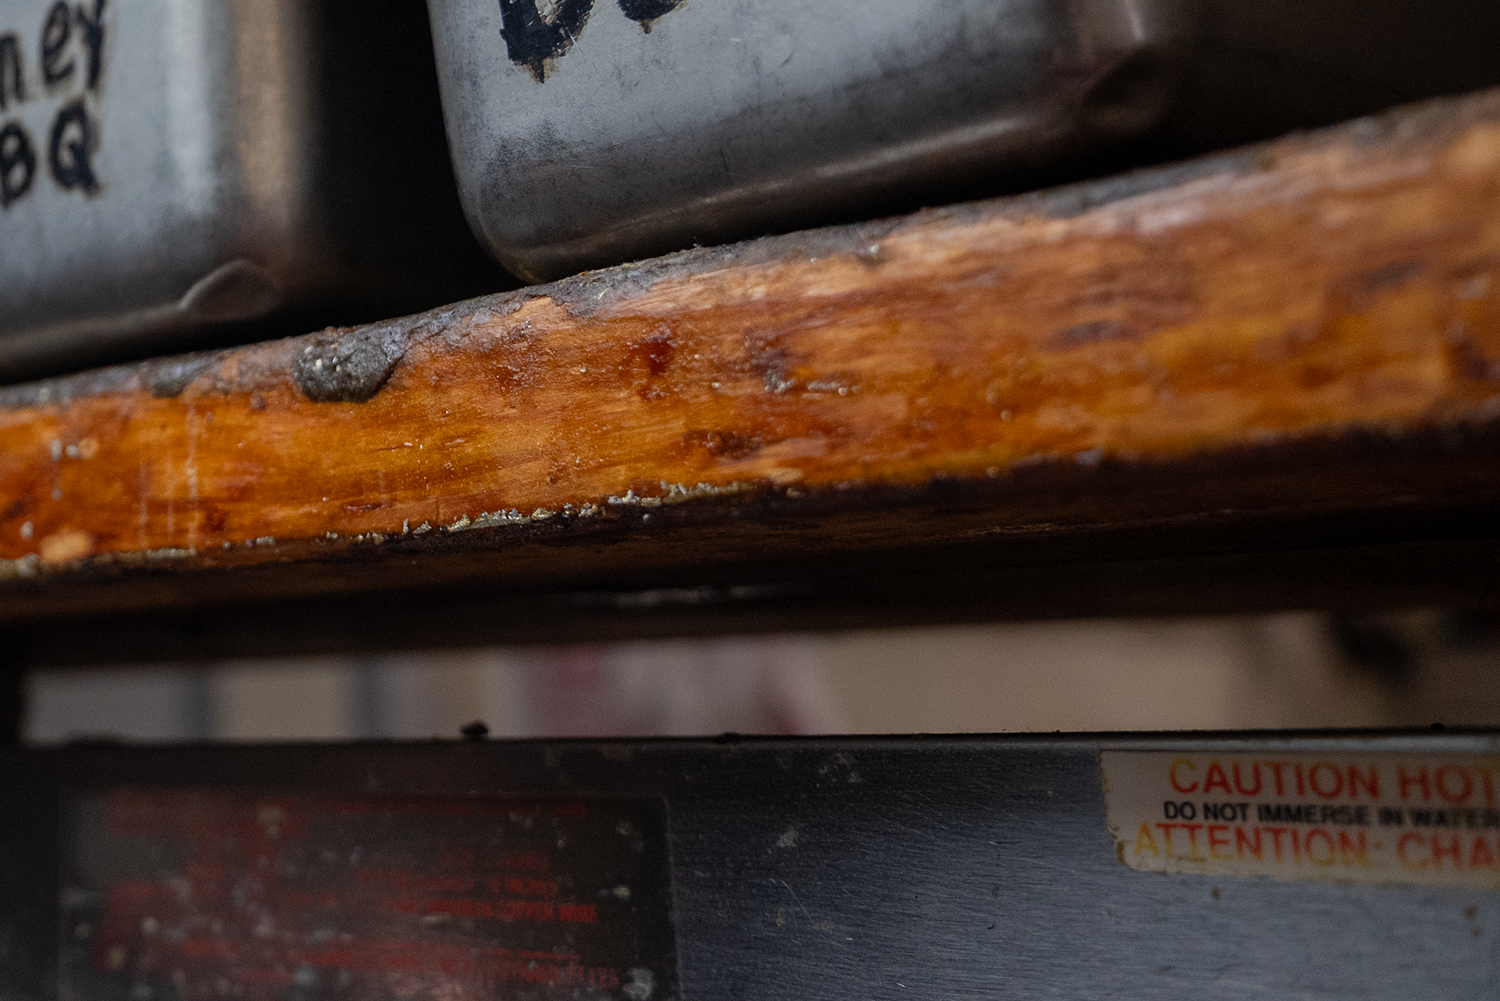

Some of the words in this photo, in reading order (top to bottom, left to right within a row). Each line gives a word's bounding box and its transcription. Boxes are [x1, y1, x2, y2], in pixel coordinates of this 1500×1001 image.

[1168, 758, 1381, 798] CAUTION
[1164, 801, 1195, 821] DO
[1203, 803, 1250, 822] NOT
[1258, 804, 1370, 826] IMMERSE
[1378, 806, 1403, 827] IN
[1397, 832, 1500, 873] CHA
